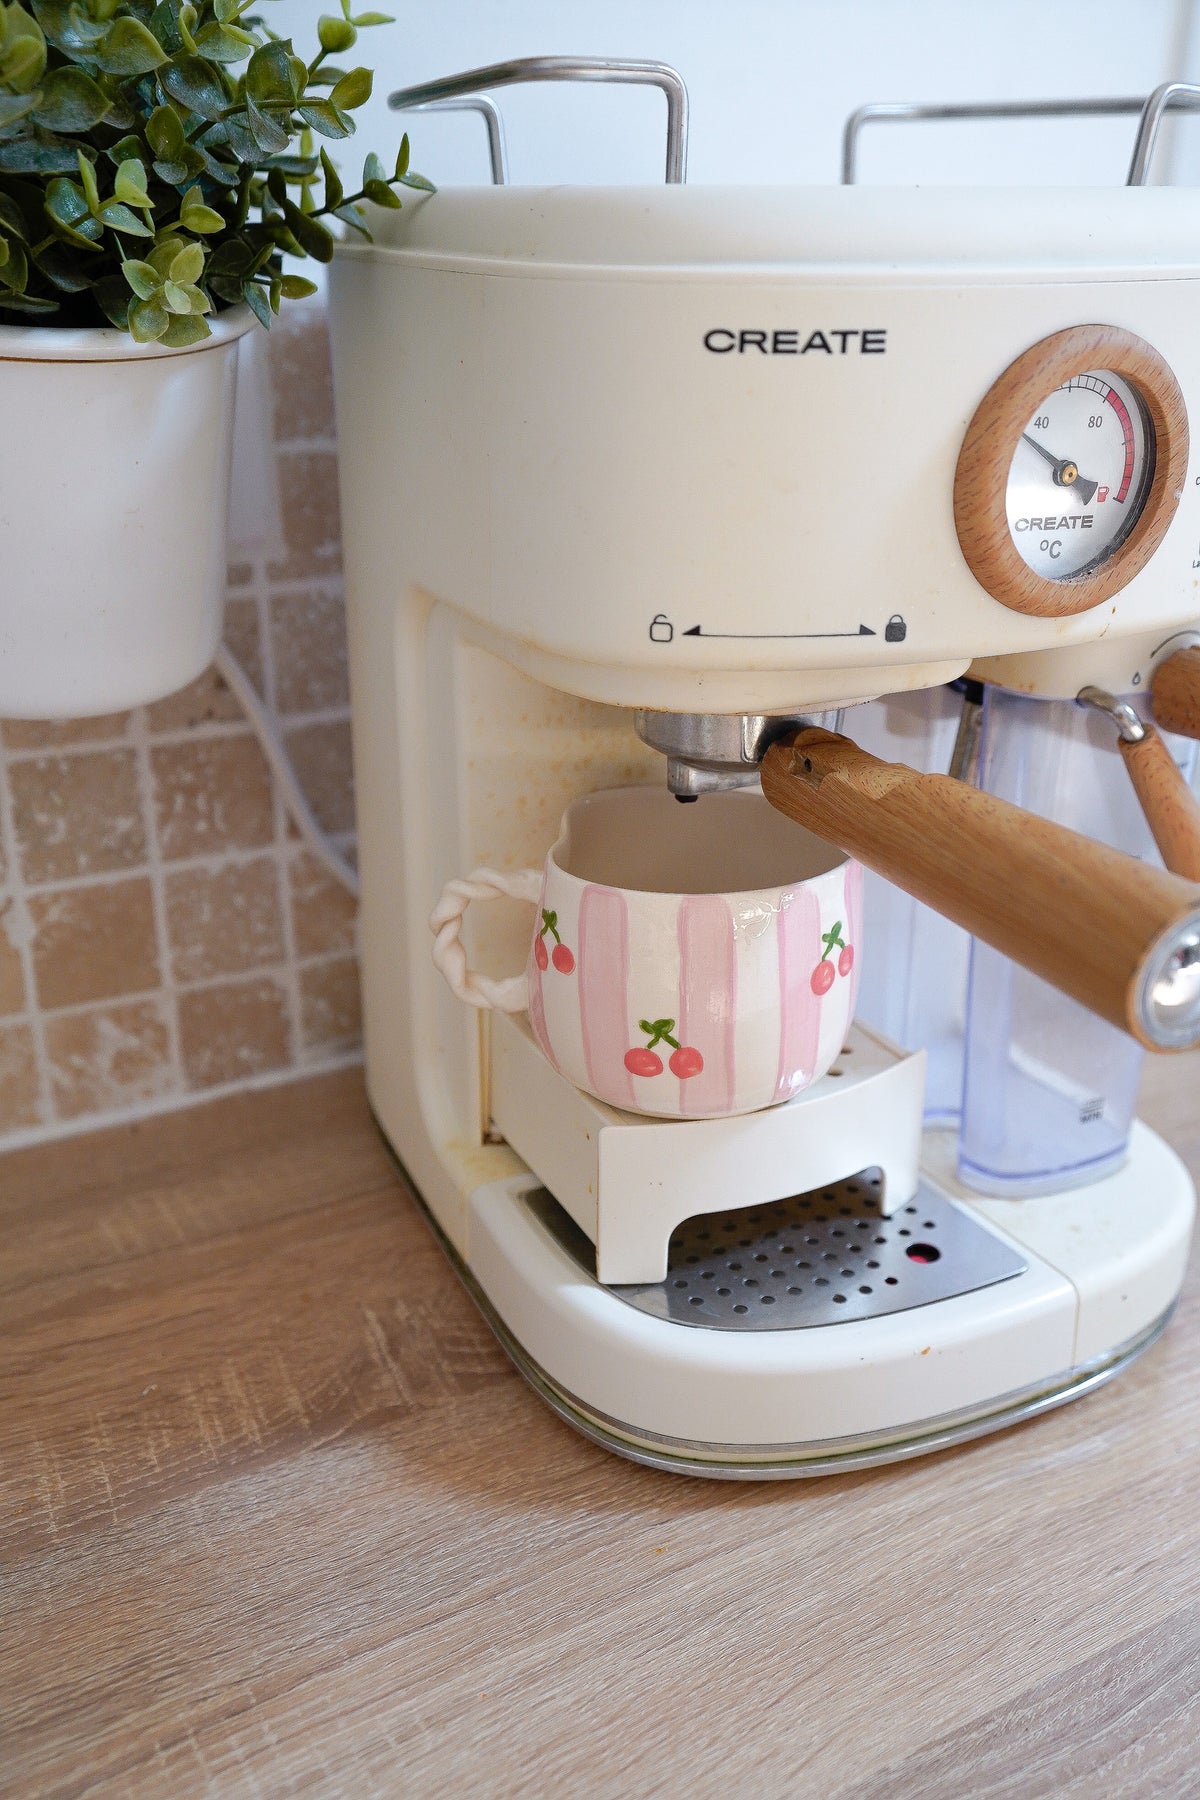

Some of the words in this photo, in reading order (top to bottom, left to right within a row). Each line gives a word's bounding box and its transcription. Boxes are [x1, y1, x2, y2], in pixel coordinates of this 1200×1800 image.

[704, 329, 886, 354] CREATE
[1033, 416, 1050, 429] 40
[1087, 415, 1103, 428] 80
[1014, 515, 1094, 532] CREATE
